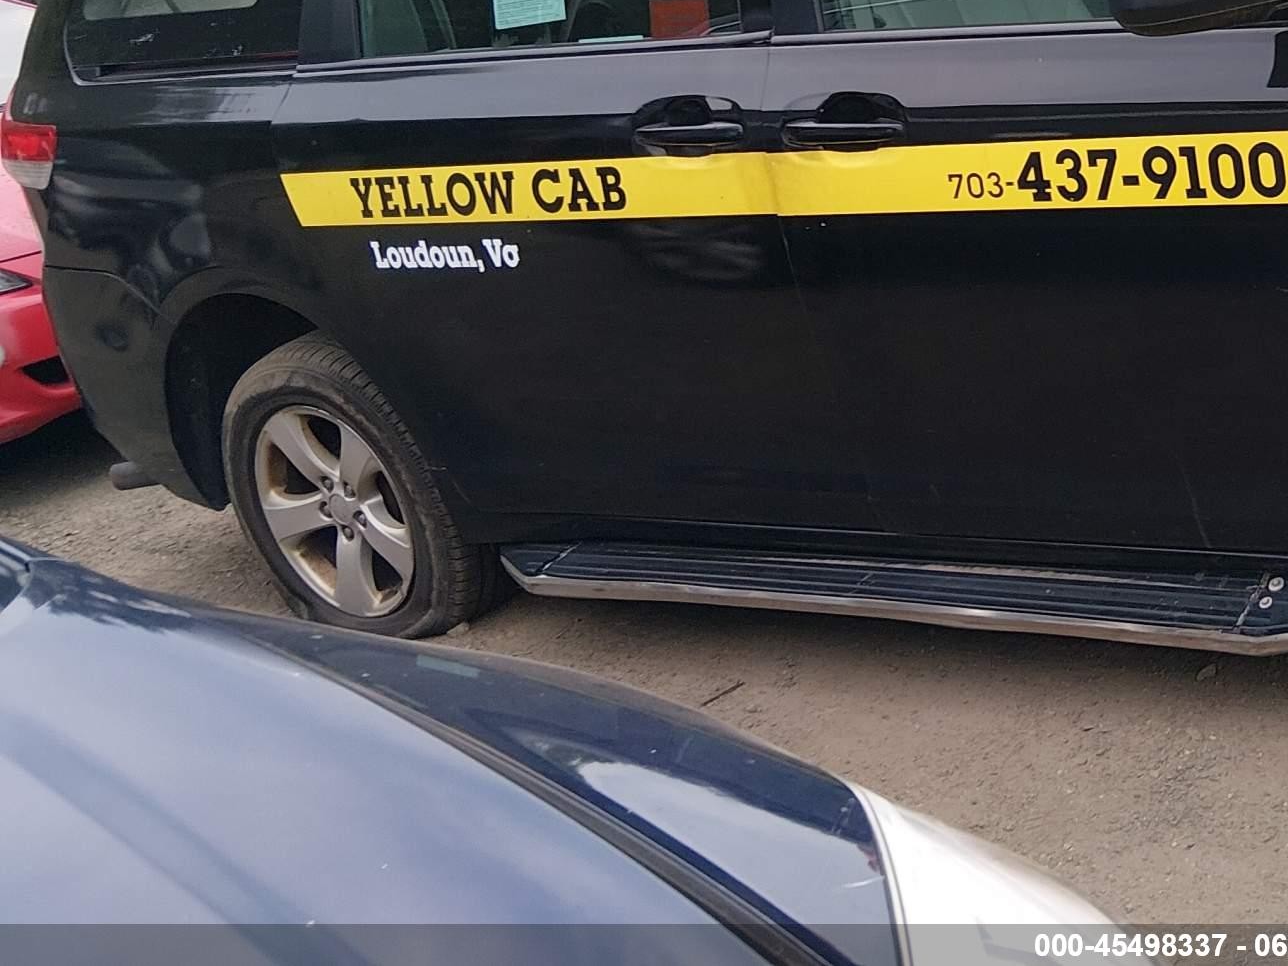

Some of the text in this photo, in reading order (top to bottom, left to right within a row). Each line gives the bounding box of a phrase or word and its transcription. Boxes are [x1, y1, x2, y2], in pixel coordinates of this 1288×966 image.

[349, 166, 627, 219] YELLOW CAB
[947, 141, 1287, 203] 703-437-9100
[369, 240, 486, 273] Loudoun,
